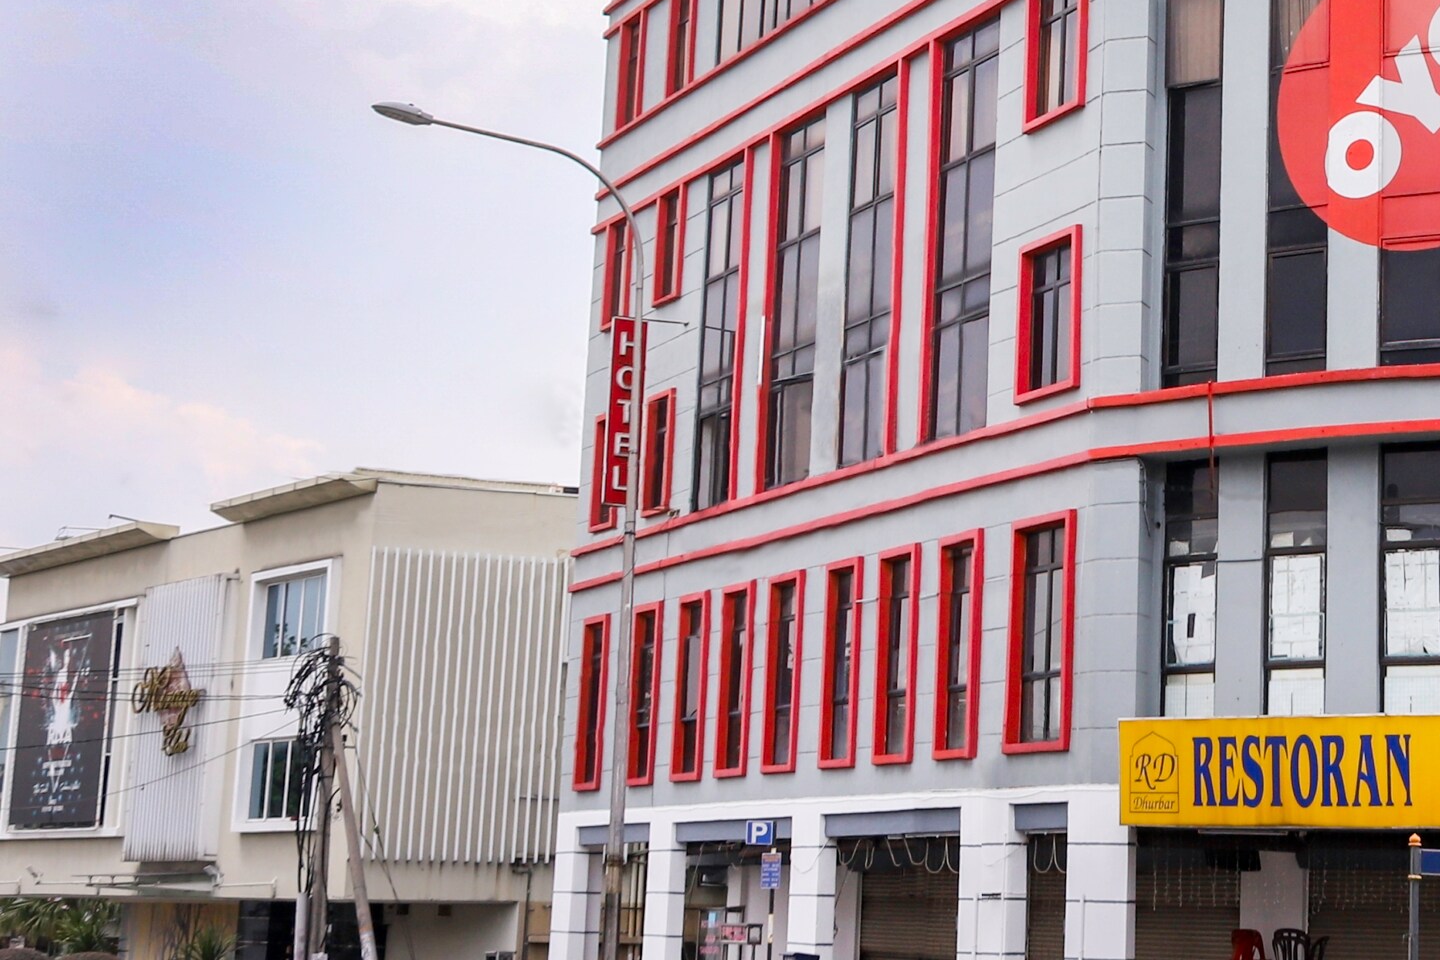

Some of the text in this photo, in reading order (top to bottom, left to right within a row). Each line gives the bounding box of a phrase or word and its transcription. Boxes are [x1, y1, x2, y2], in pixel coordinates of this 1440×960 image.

[1134, 753, 1176, 790] RD
[1192, 733, 1413, 809] RESTORAN
[1133, 794, 1176, 810] Dhurbar
[751, 822, 768, 844] P
